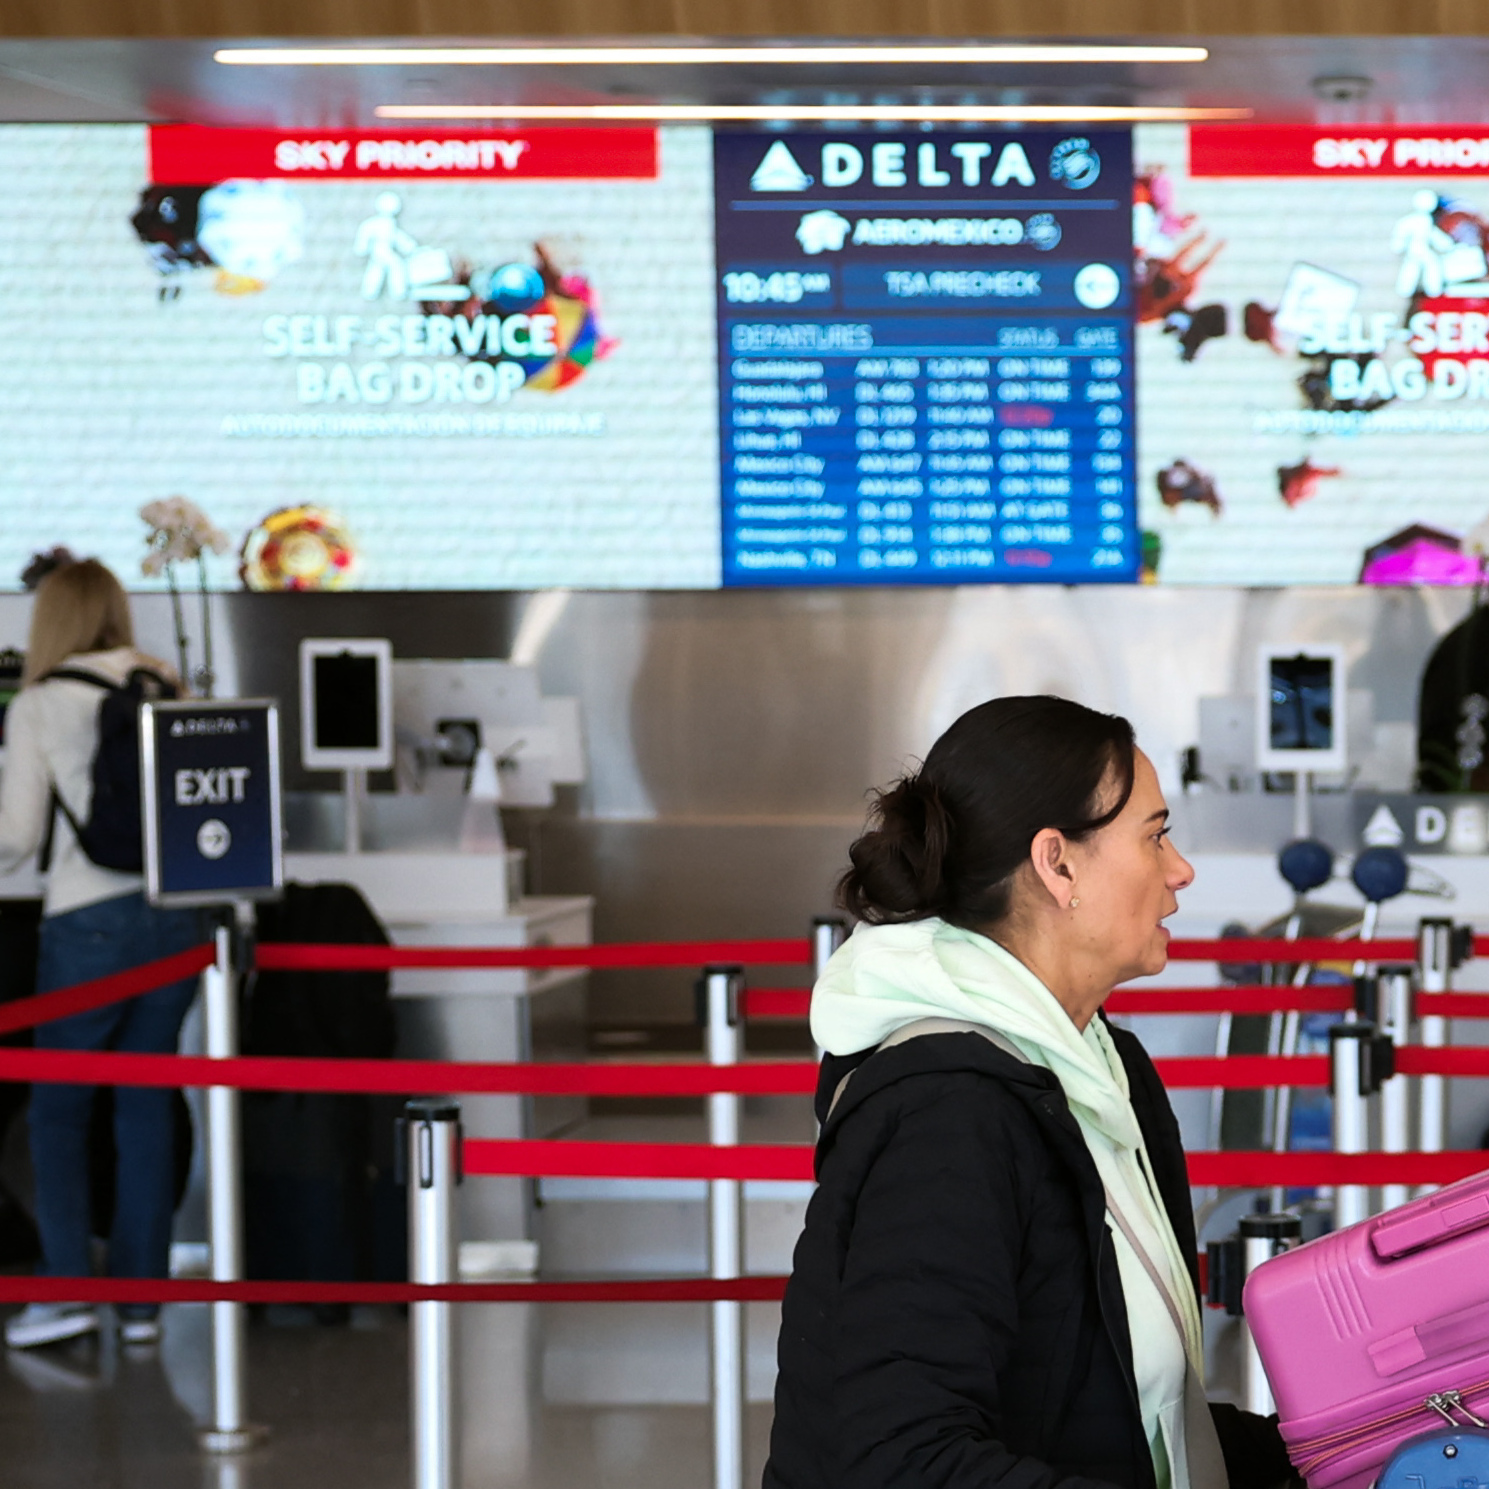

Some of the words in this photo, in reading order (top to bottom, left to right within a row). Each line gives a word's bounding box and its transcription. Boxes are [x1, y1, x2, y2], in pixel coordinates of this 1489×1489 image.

[276, 141, 350, 170] SKY
[357, 141, 524, 170] PRIORITY
[821, 142, 1036, 187] DELTA
[1312, 139, 1388, 168] SKY
[852, 218, 1024, 246] AEROMEXICO
[262, 314, 557, 356] SELF-SERVICE
[299, 362, 391, 404] BAG
[399, 362, 526, 404] DROP
[1329, 359, 1426, 401] BAG
[175, 766, 251, 806] EXIT
